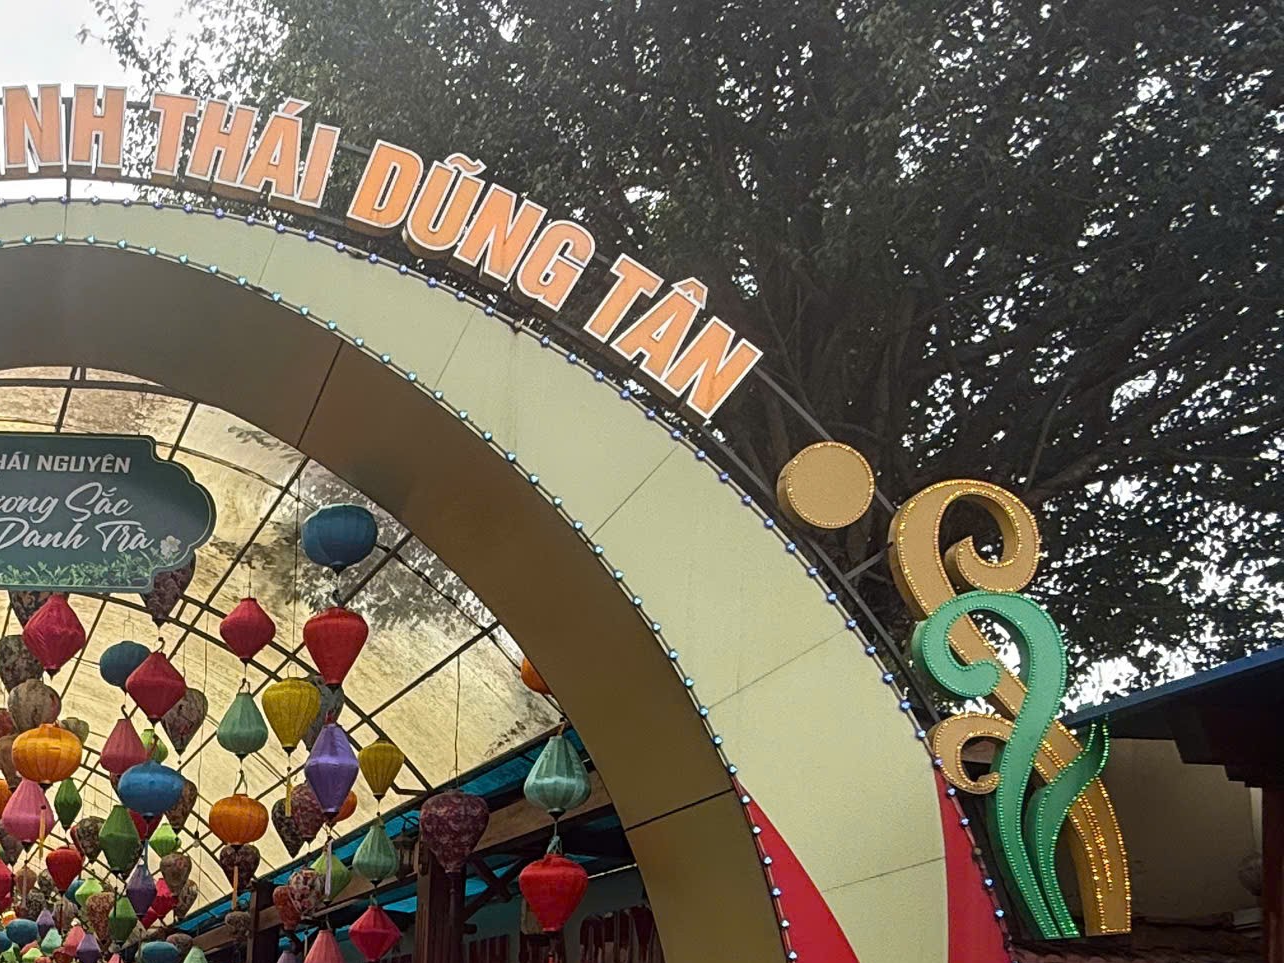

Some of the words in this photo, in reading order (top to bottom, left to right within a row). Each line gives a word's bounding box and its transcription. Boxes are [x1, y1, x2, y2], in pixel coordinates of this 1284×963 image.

[150, 92, 341, 209] THÁI
[346, 139, 596, 313] DŨNG
[583, 252, 764, 421] TÂN
[36, 454, 132, 474] NGUYÊN
[65, 481, 134, 523] Sắc
[95, 520, 155, 553] Trà
